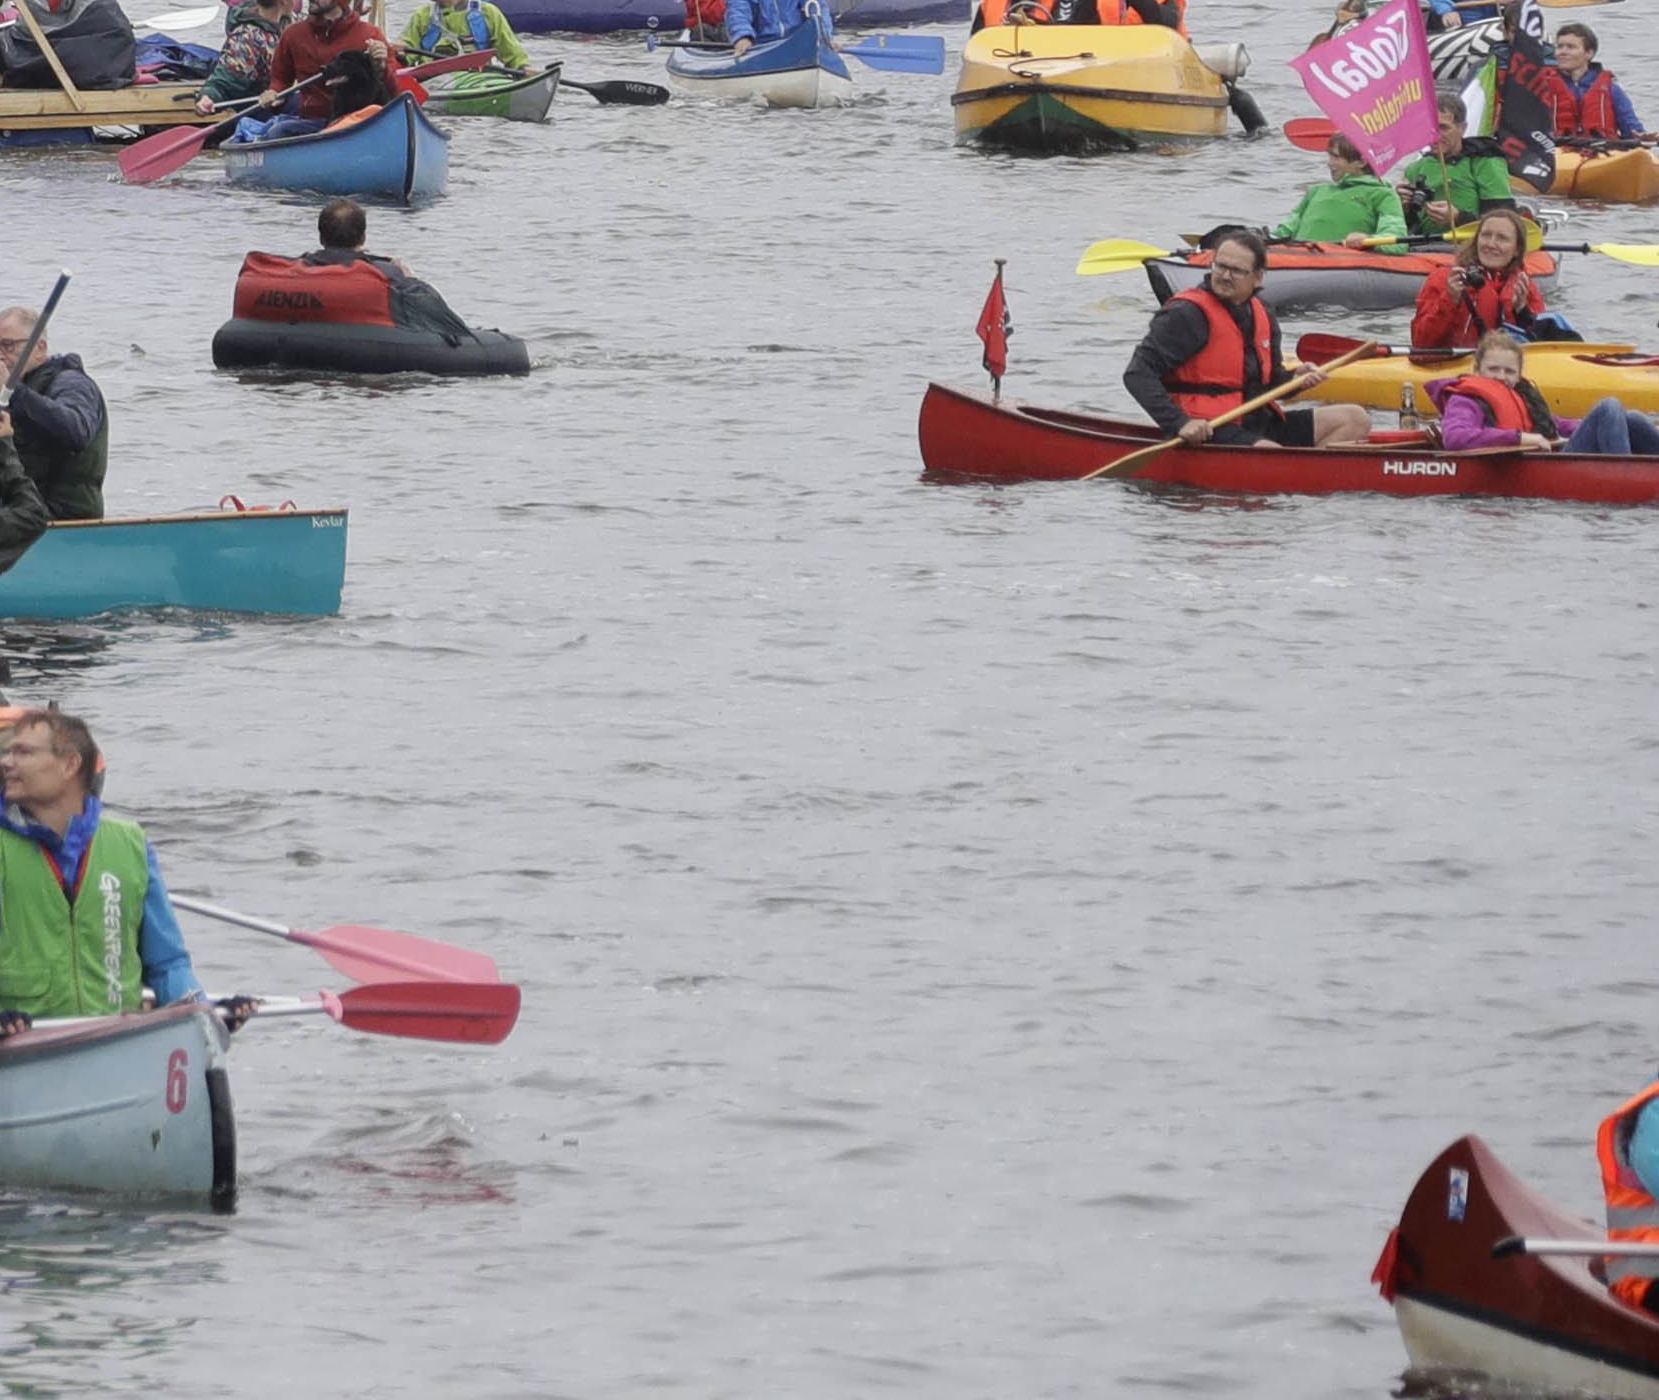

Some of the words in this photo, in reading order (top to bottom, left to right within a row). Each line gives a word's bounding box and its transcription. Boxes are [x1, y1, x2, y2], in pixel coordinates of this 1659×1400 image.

[1383, 461, 1457, 476] HURON
[311, 515, 344, 529] Kevlar
[165, 1047, 189, 1114] 6
